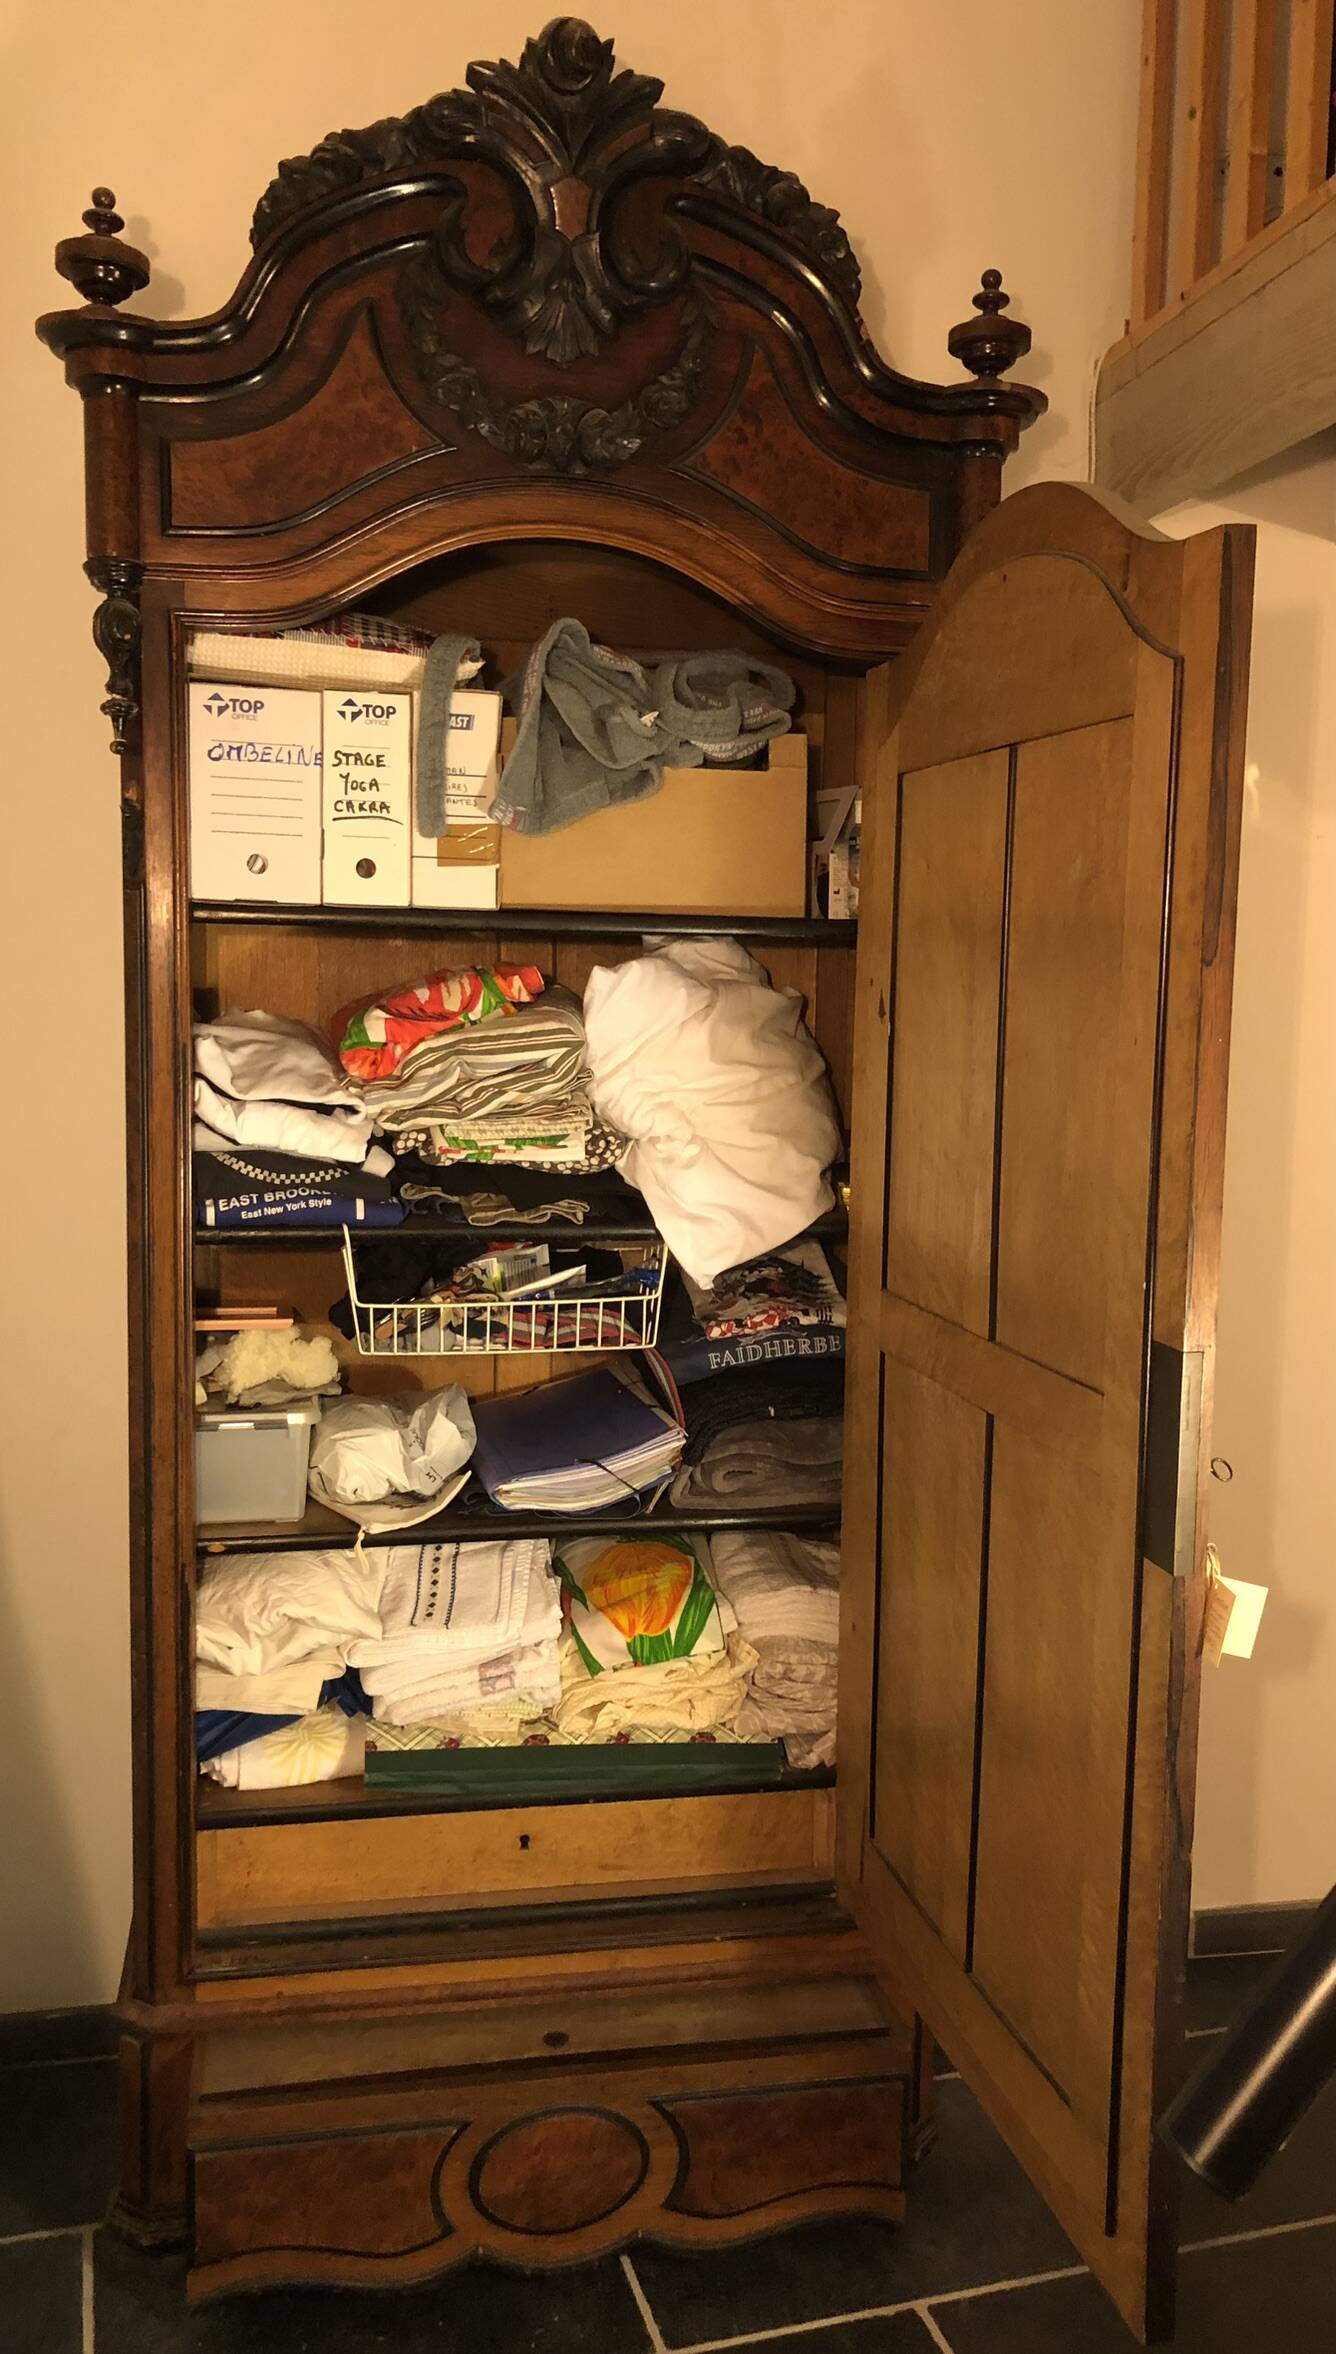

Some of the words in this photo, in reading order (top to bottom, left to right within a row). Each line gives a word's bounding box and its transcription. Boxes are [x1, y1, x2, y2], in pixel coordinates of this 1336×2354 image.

[229, 698, 264, 713] TOP
[362, 704, 396, 719] TOP
[450, 715, 470, 729] AST
[207, 742, 323, 767] OMBELINE
[331, 750, 386, 768] STAGE
[339, 772, 380, 795] YOGA
[334, 800, 391, 814] CAKRA
[218, 1193, 260, 1212] EAST
[241, 1209, 263, 1220] East
[263, 1205, 285, 1216] New
[285, 1201, 307, 1213] York
[308, 1198, 332, 1209] Style
[708, 1335, 841, 1369] FAIDHERBE
